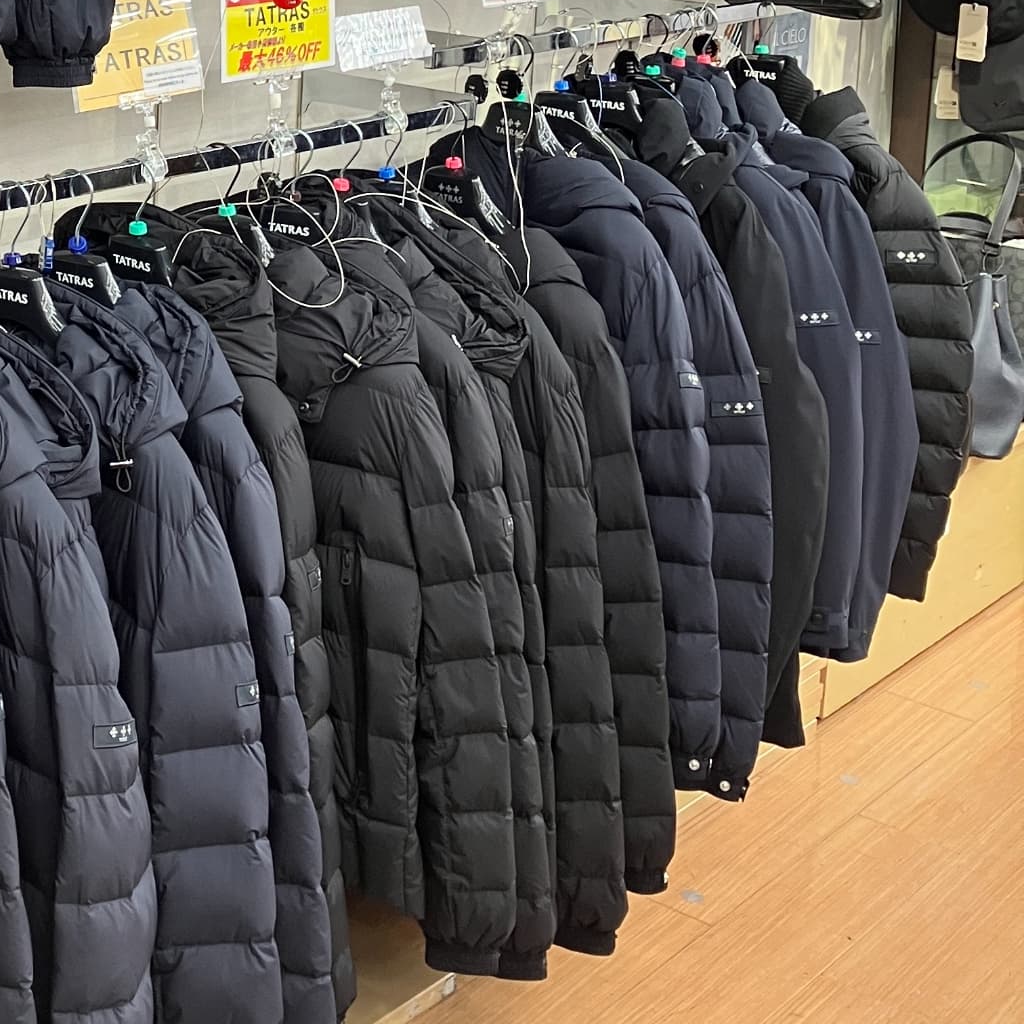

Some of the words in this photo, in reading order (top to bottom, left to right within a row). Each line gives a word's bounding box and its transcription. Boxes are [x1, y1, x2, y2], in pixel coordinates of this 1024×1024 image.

[244, 1, 311, 27] TATRAS
[104, 42, 182, 73] ATRAS
[744, 69, 776, 81] TATRAS
[541, 105, 576, 120] TATRAS
[589, 98, 626, 111] TATRAS
[267, 221, 311, 237] TATRAS
[112, 253, 151, 273] TATRAS
[55, 271, 94, 289] TATRAS
